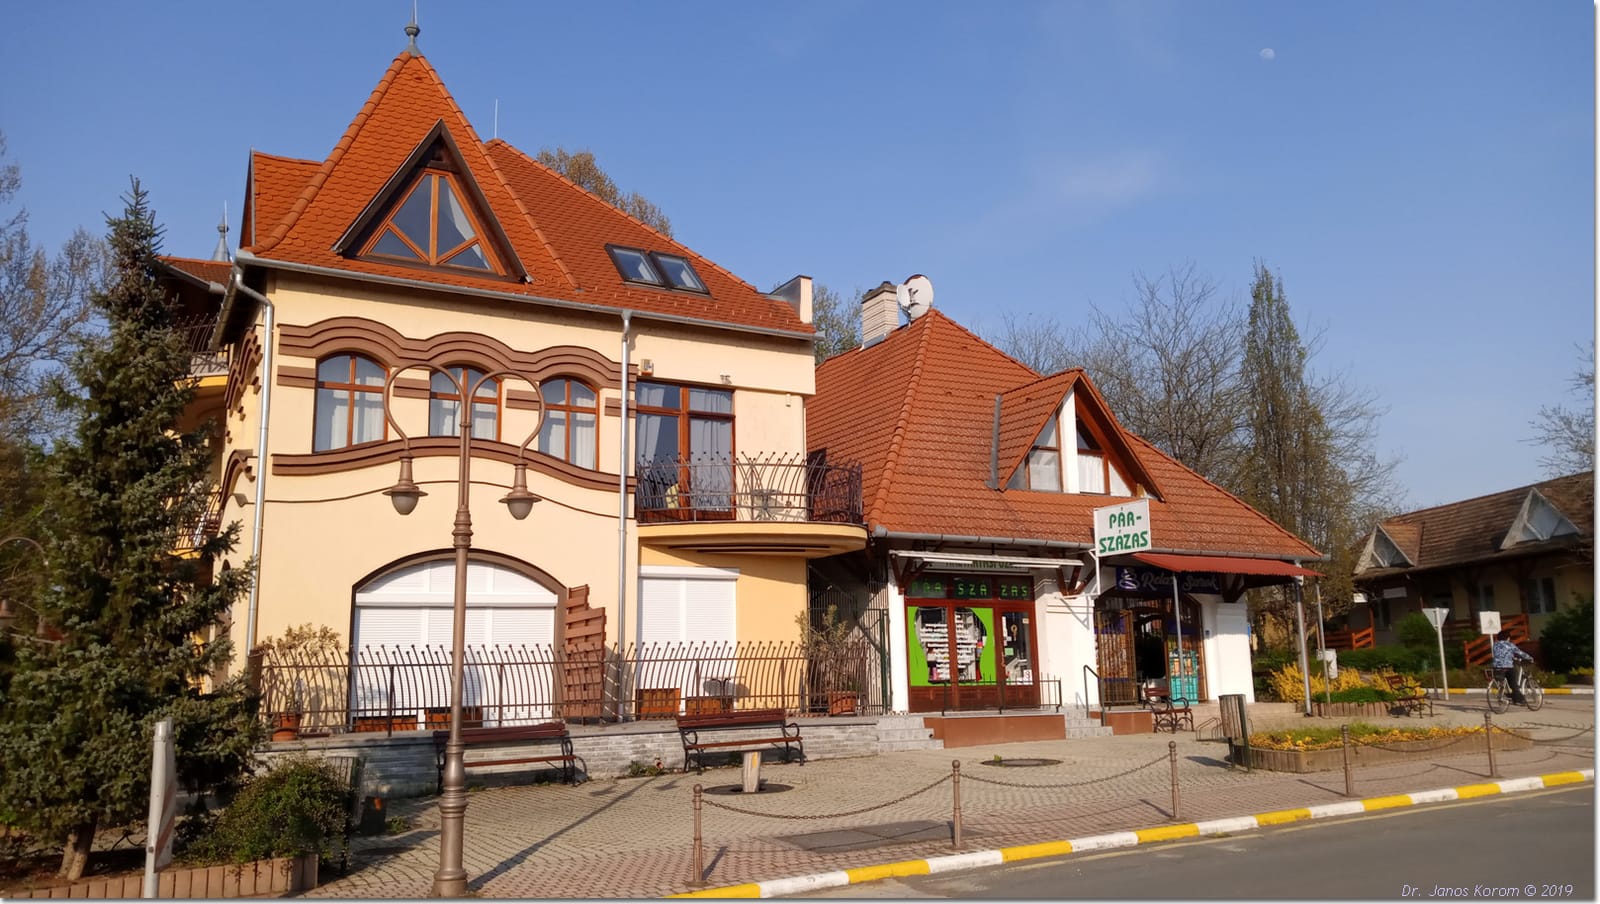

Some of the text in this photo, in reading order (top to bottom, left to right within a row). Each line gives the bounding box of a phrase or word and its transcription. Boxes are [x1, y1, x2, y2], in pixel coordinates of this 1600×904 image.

[1109, 506, 1142, 529] PÁR-
[1098, 529, 1148, 554] SZÁZAS
[1000, 583, 1028, 597] ZAS
